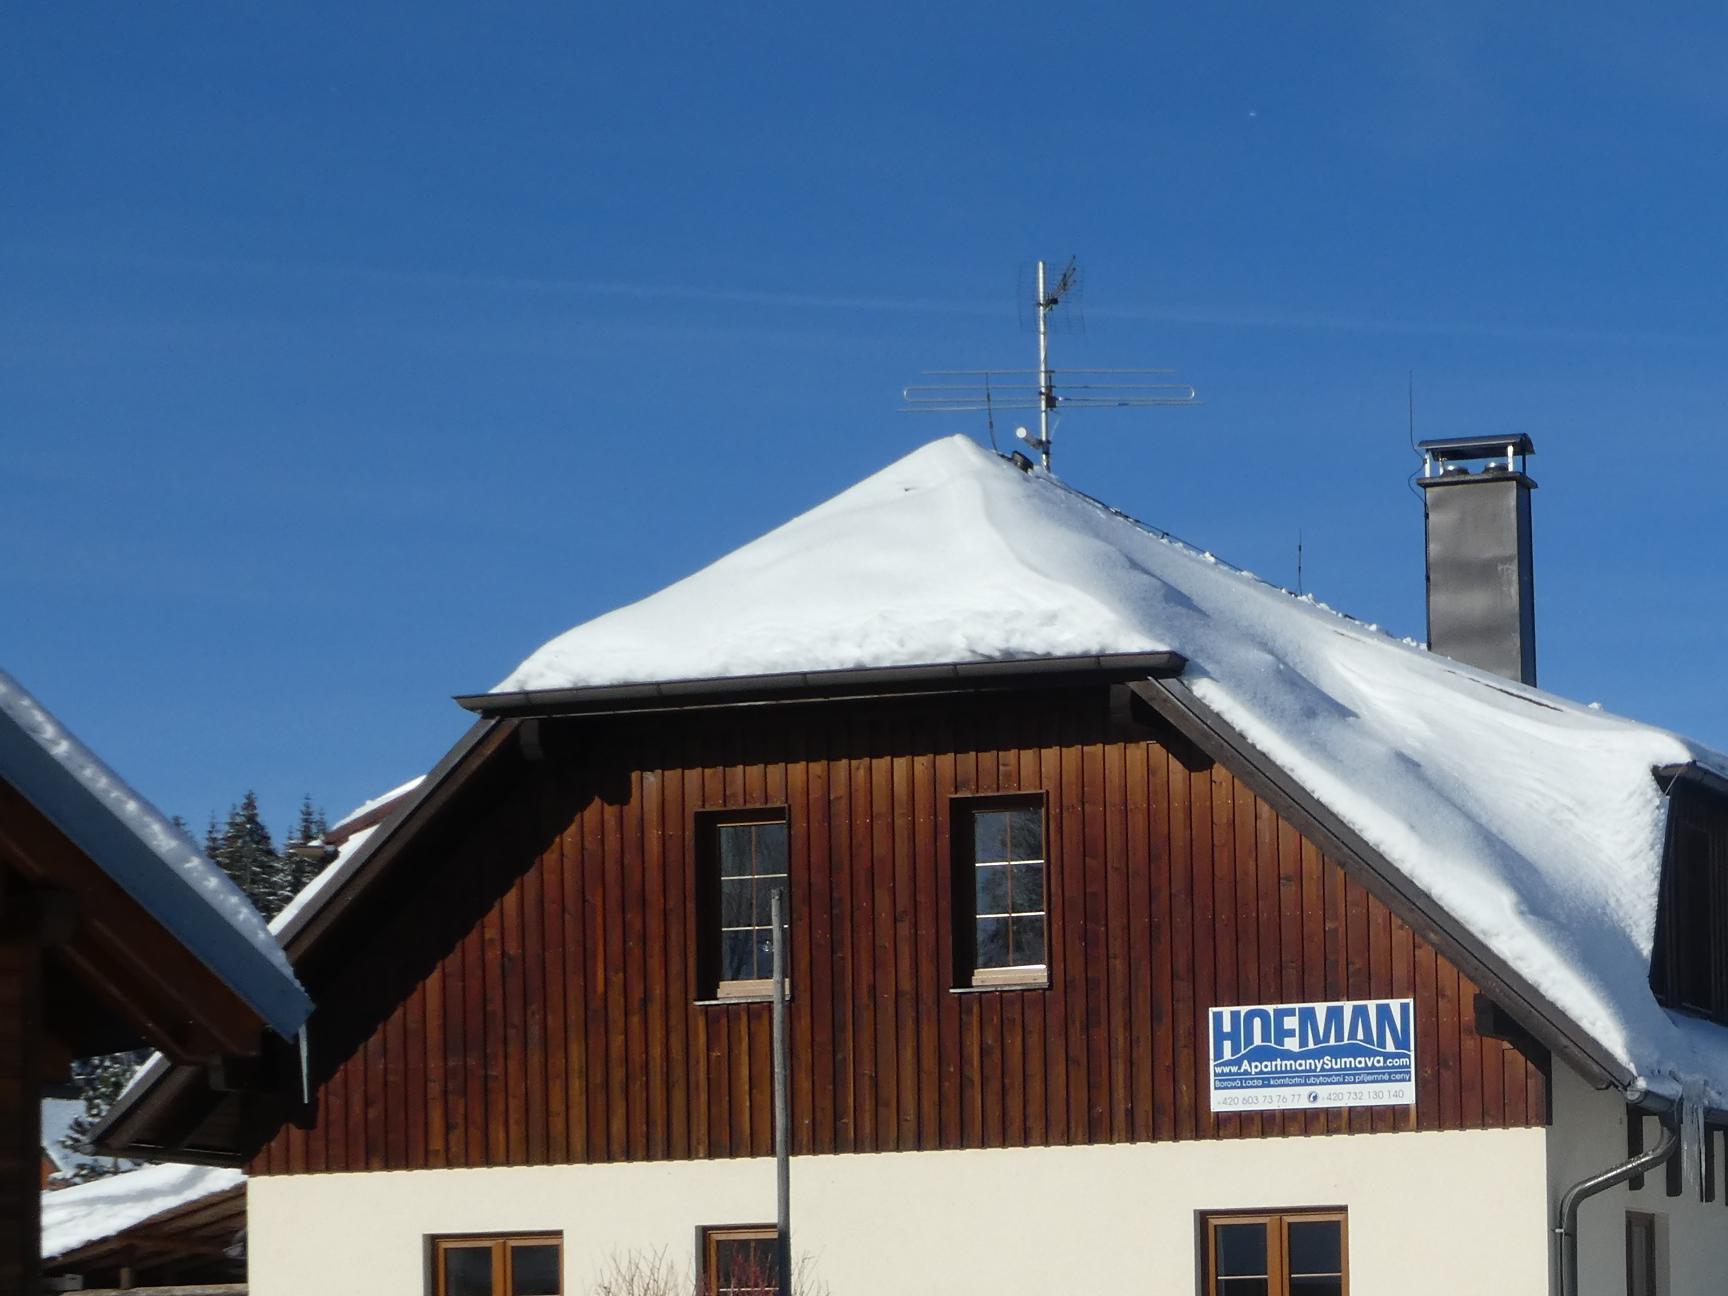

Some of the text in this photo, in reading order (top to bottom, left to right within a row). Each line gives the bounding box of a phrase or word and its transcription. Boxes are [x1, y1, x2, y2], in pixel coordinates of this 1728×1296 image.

[1212, 1002, 1411, 1062] HOFMAN
[1214, 1055, 1410, 1075] www.ApartmanySumava.com
[1215, 1079, 1241, 1088] Borová
[1242, 1079, 1262, 1087] Lada
[1390, 1073, 1411, 1081] ceny
[1241, 1095, 1260, 1105] 603
[1262, 1094, 1274, 1104] 73
[1276, 1094, 1288, 1104] 76
[1291, 1093, 1302, 1103] 77
[1346, 1091, 1364, 1101] 732
[1367, 1090, 1384, 1100] 130
[1387, 1089, 1405, 1099] 140
